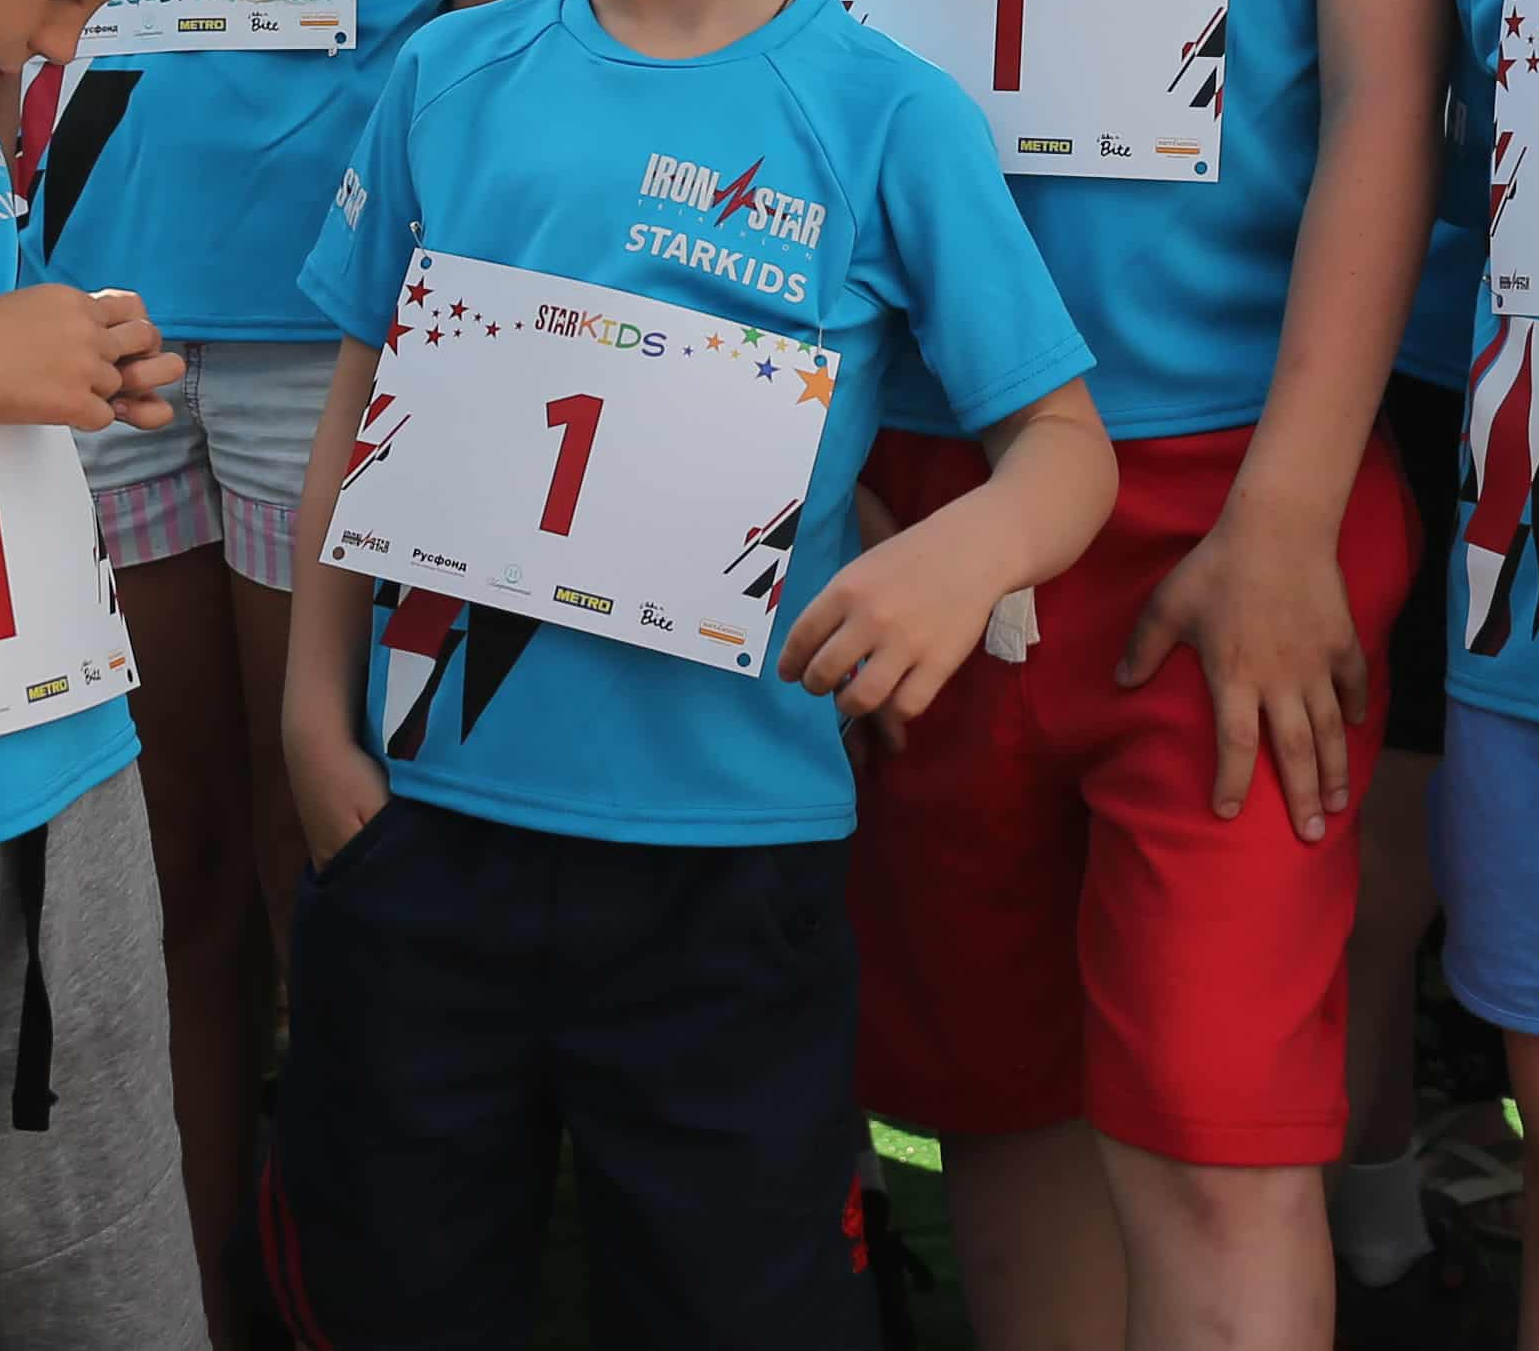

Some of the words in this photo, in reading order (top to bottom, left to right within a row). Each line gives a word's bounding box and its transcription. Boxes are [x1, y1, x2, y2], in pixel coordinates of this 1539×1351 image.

[82, 24, 119, 34] усфонд
[180, 20, 225, 31] METRO
[1020, 140, 1070, 153] METRO
[1099, 140, 1133, 158] Bite
[625, 223, 808, 304] STARKIDS
[535, 304, 668, 358] STARKIDS
[540, 393, 605, 537] 1
[412, 548, 467, 572] Русфонд
[556, 588, 611, 613] METRO
[640, 609, 674, 632] Bite
[28, 679, 68, 700] METRO
